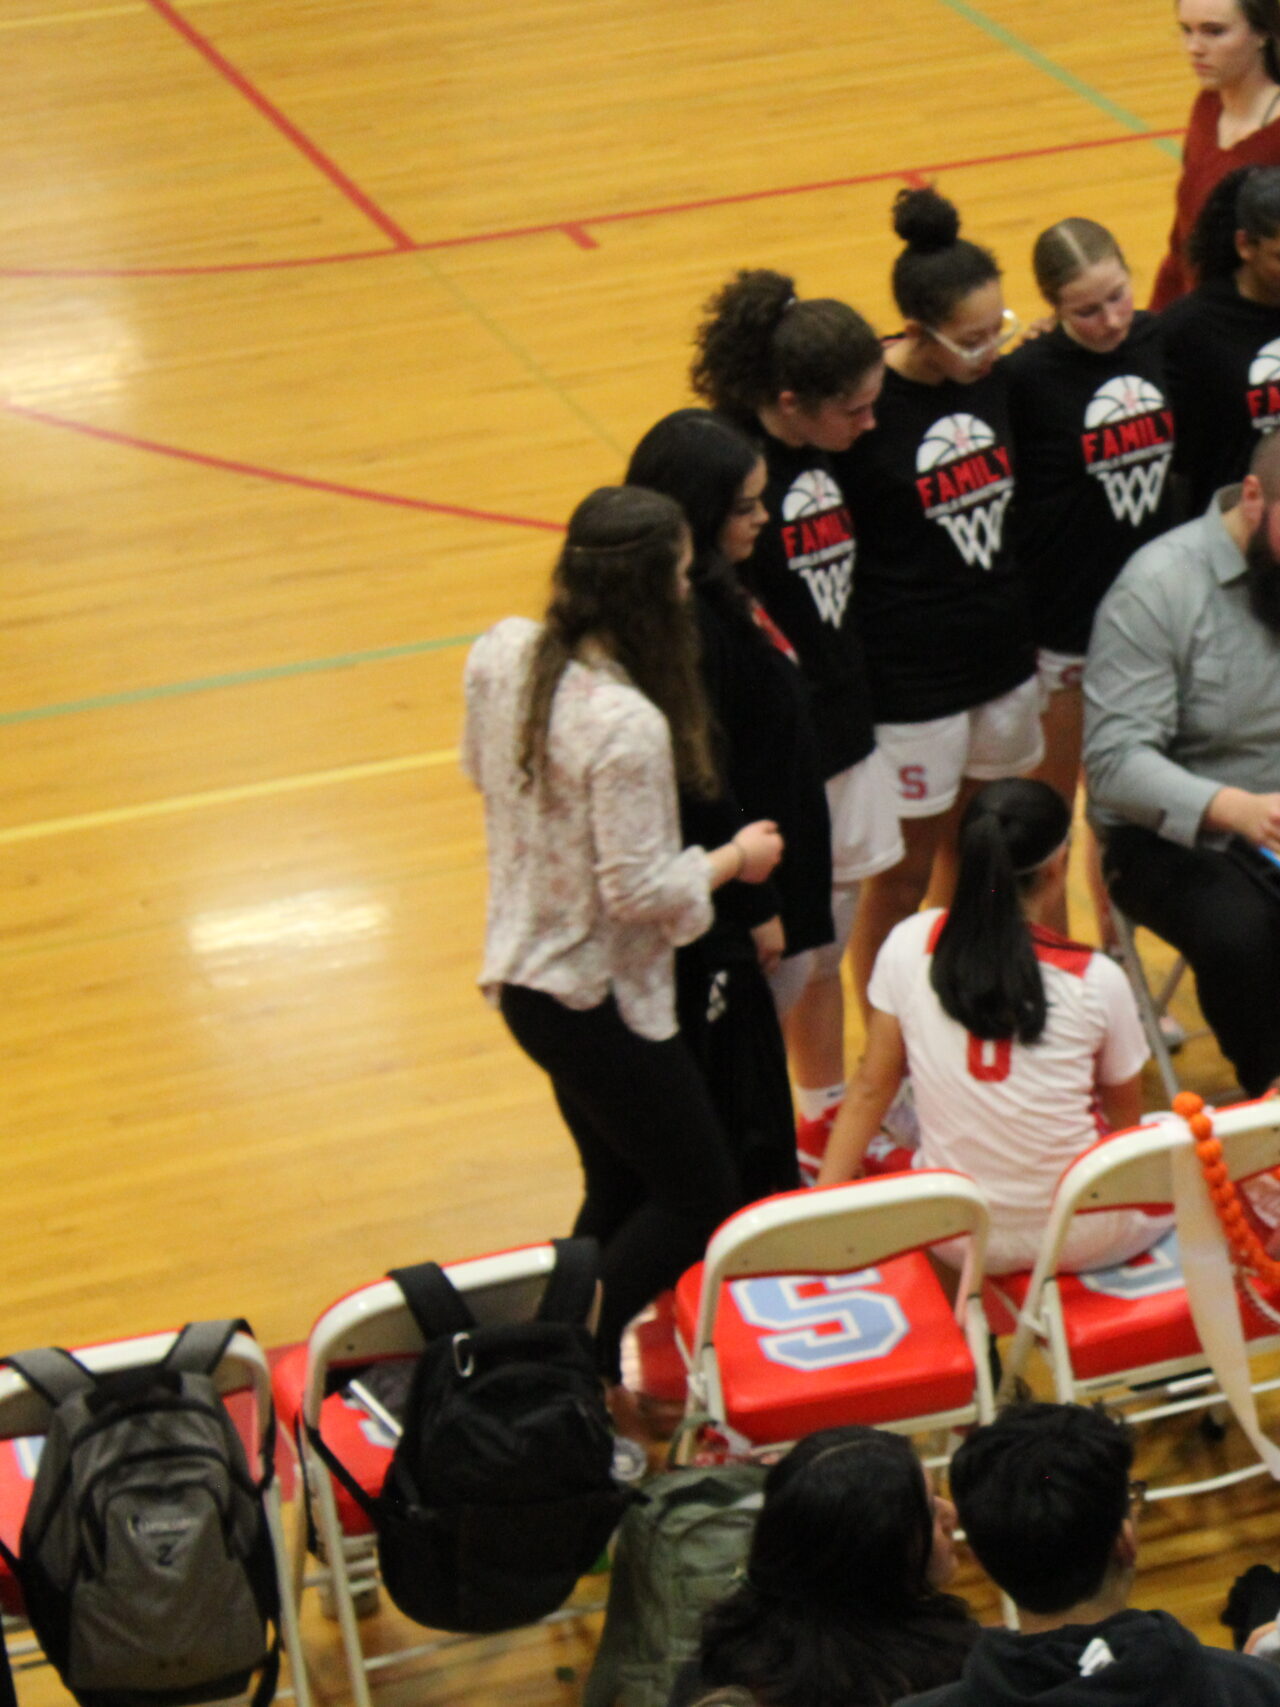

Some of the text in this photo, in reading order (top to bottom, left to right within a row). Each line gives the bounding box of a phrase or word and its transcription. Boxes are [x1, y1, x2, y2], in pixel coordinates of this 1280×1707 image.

[1081, 411, 1175, 464] FAMILY
[915, 446, 1013, 508] FAMILY
[900, 765, 928, 800] S
[729, 1266, 911, 1371] S
